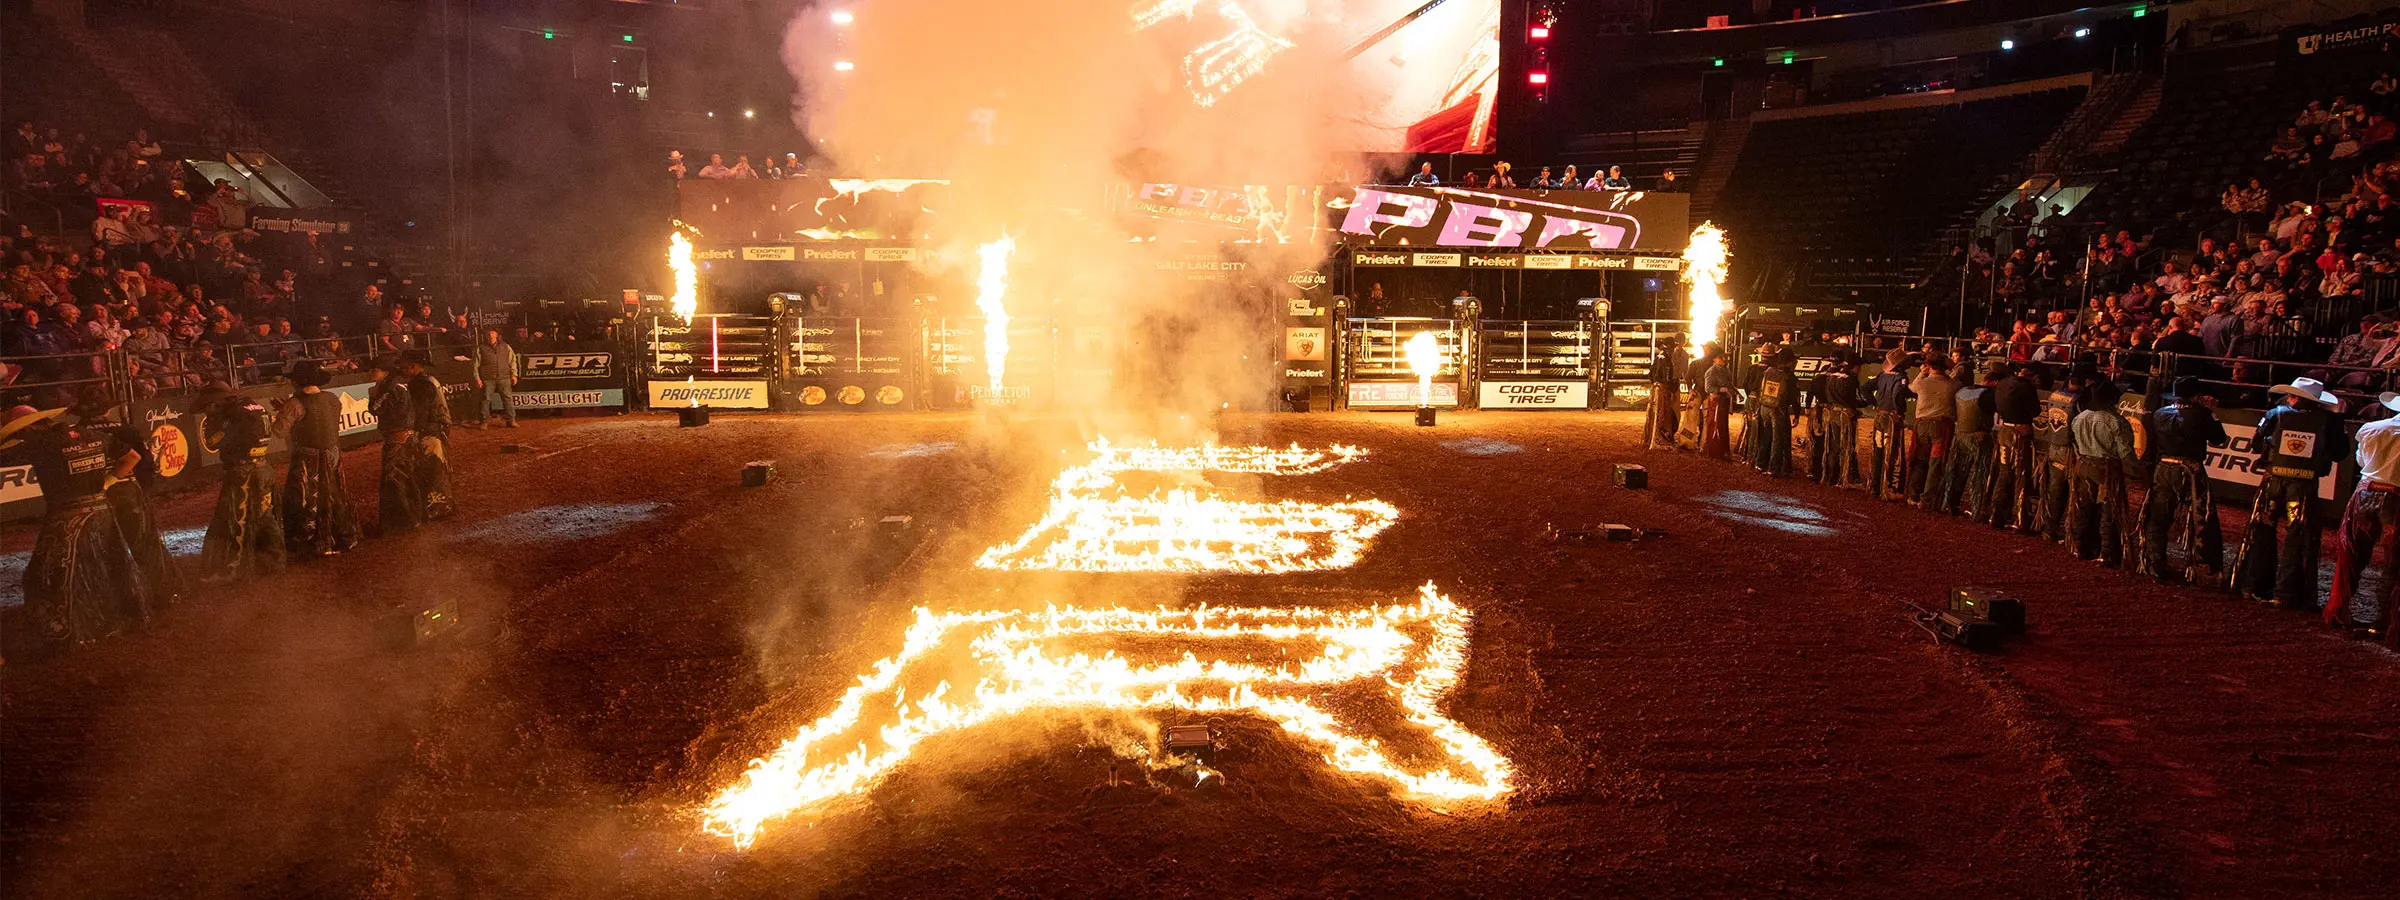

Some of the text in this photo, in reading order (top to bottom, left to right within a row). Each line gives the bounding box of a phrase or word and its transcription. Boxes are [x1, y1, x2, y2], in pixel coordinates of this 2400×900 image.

[2325, 26, 2379, 44] HEALTH
[252, 216, 290, 234] Farming
[291, 217, 336, 233] Simulator
[803, 248, 857, 260] Priefert
[1356, 254, 1406, 265] Priefert
[1155, 261, 1247, 270] SALT LAKE CITY
[1468, 255, 1518, 267] Priefert
[1579, 256, 1627, 268] Priefert
[1287, 275, 1327, 284] LUCAS OIL
[1882, 325, 1909, 333] RESERVE
[525, 369, 567, 377] UNLEASH
[577, 368, 607, 376] BEAST
[1285, 367, 1325, 378] Priefert
[660, 387, 754, 401] PROGRESSIVE
[1350, 384, 1381, 401] FRE
[1499, 385, 1569, 394] COOPER
[1632, 388, 1651, 396] FINALS
[1508, 395, 1557, 404] TIRES
[160, 427, 178, 443] Bass
[2283, 432, 2314, 441] ARIAT
[163, 441, 177, 456] Pro
[165, 454, 186, 471] Shops
[2205, 451, 2267, 477] TIRE
[2271, 466, 2315, 479] CHAMPION
